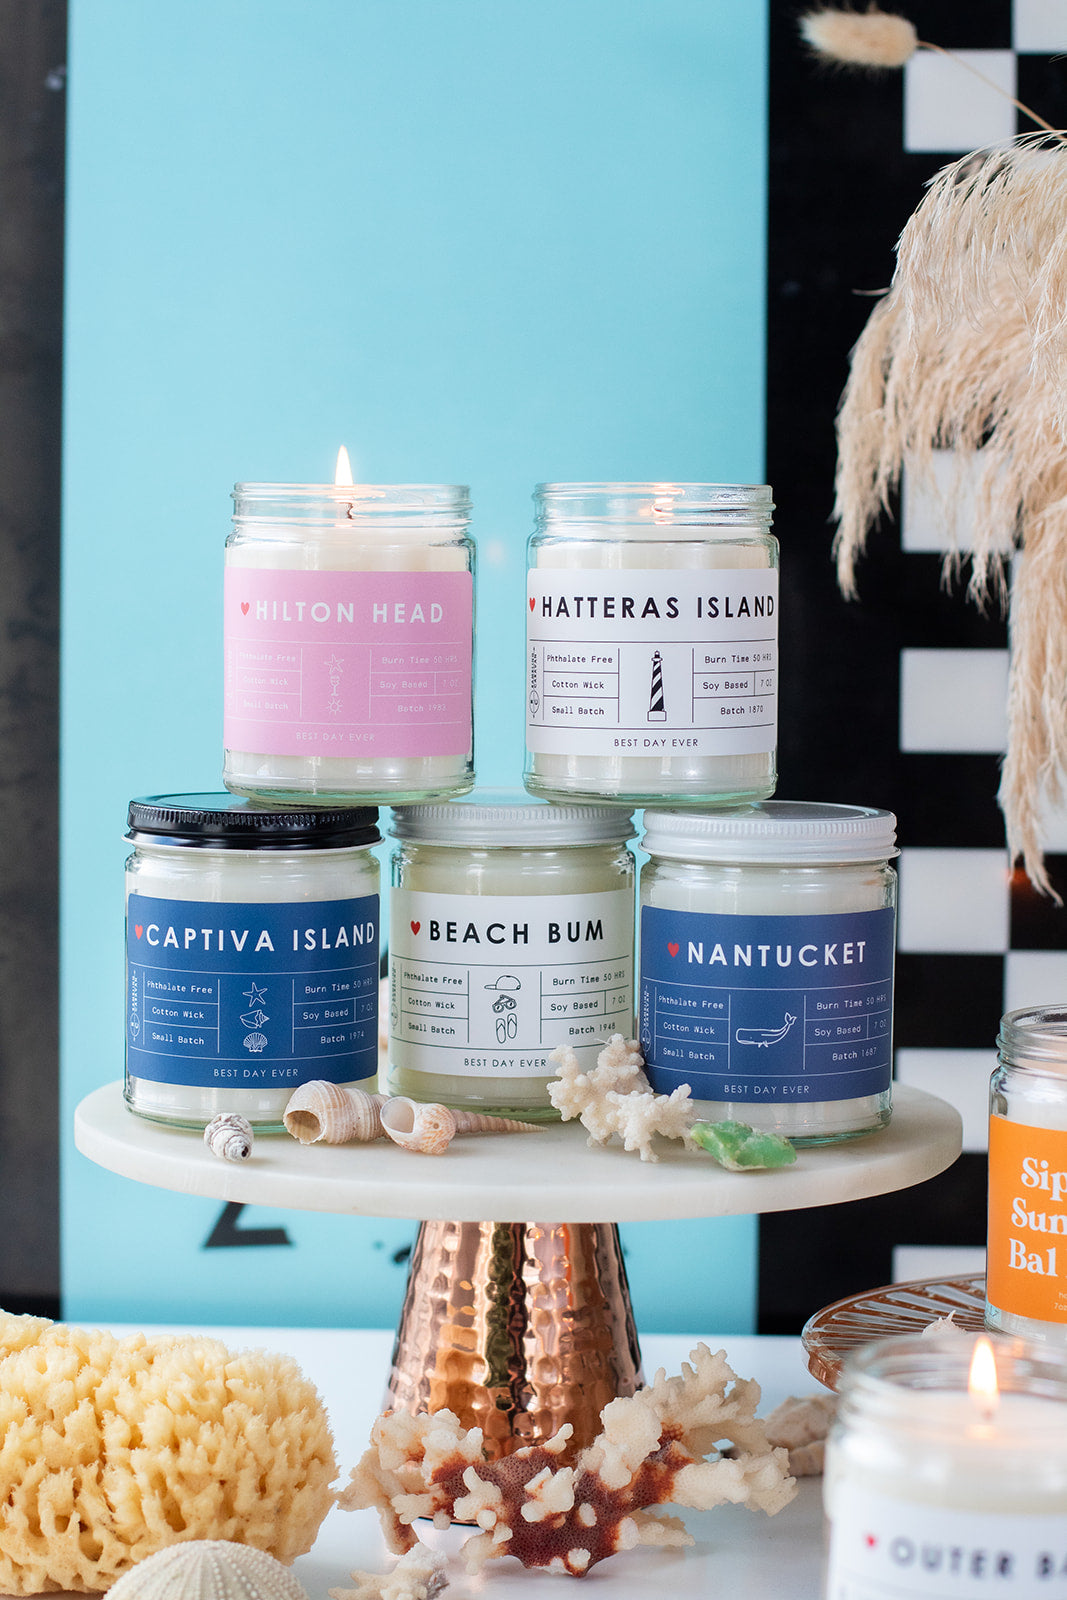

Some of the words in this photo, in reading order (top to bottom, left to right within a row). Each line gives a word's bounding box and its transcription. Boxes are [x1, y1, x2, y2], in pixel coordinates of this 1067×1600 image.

[256, 601, 354, 623] HILTON
[373, 603, 443, 623] HEAD
[542, 596, 679, 619] HATTERAS
[697, 595, 774, 618] ISLAND
[382, 656, 404, 665] Burn
[409, 656, 429, 664] Time
[546, 655, 586, 664] Phthalate
[591, 656, 613, 664] Free
[705, 656, 727, 664] Burn
[753, 654, 760, 662] 50
[379, 680, 396, 689] Soy
[402, 680, 428, 688] Based
[552, 681, 579, 689] Cotton
[583, 681, 604, 689] Wick
[703, 682, 719, 691] Soy
[725, 681, 748, 689] Based
[398, 704, 424, 712] Batch
[552, 706, 573, 715] Small
[578, 707, 604, 715] Batch
[720, 707, 745, 715] Batch
[749, 705, 764, 713] 1870
[296, 732, 318, 741] BEST
[323, 733, 344, 741] DAY
[349, 733, 375, 742] EVER
[614, 739, 638, 747] BEST
[643, 739, 666, 747] DAY
[672, 739, 698, 747] EVER
[146, 924, 275, 951] CAPTIVA
[293, 922, 374, 950] ISLAND
[430, 920, 528, 944] BEACH
[548, 920, 604, 943] BUM
[688, 941, 866, 967] NANTUCKET
[404, 972, 438, 984] Phthalate
[442, 976, 463, 985] Free
[553, 978, 575, 986] Burn
[580, 975, 599, 983] Time
[604, 973, 612, 981] 50
[147, 981, 187, 992] Phthalate
[191, 984, 213, 994] Free
[305, 985, 327, 994] Burn
[331, 982, 350, 991] Time
[408, 997, 431, 1008] Cotton
[435, 1000, 455, 1009] Wick
[550, 1003, 567, 1012] Soy
[573, 1001, 598, 1010] Based
[659, 996, 697, 1007] Phthalate
[702, 1000, 724, 1009] Free
[816, 1001, 839, 1010] Burn
[844, 999, 862, 1008] Time
[152, 1006, 179, 1017] Cotton
[183, 1010, 204, 1019] Wick
[303, 1011, 319, 1021] Soy
[325, 1008, 349, 1018] Based
[408, 1022, 427, 1032] Small
[431, 1025, 456, 1035] Batch
[569, 1026, 595, 1035] Batch
[663, 1022, 689, 1032] Cotton
[694, 1025, 715, 1034] Wick
[814, 1028, 831, 1037] Soy
[837, 1025, 861, 1034] Based
[152, 1032, 173, 1043] Small
[178, 1036, 204, 1045] Batch
[320, 1035, 345, 1044] Batch
[350, 1031, 365, 1040] 1974
[663, 1047, 684, 1058] Small
[689, 1051, 715, 1060] Batch
[832, 1051, 858, 1060] Batch
[861, 1047, 877, 1057] 1687
[464, 1058, 486, 1067] BEST
[492, 1059, 514, 1067] DAY
[520, 1058, 547, 1067] EVER
[214, 1068, 238, 1077] BEST
[243, 1070, 266, 1078] DAY
[272, 1068, 299, 1077] EVER
[724, 1085, 748, 1094] BEST
[754, 1086, 777, 1094] DAY
[783, 1085, 810, 1094] EVER
[1021, 1157, 1067, 1202] Sip
[1008, 1238, 1058, 1276] Bal
[889, 1537, 1014, 1579] OUTER
[1037, 1551, 1067, 1580] B
